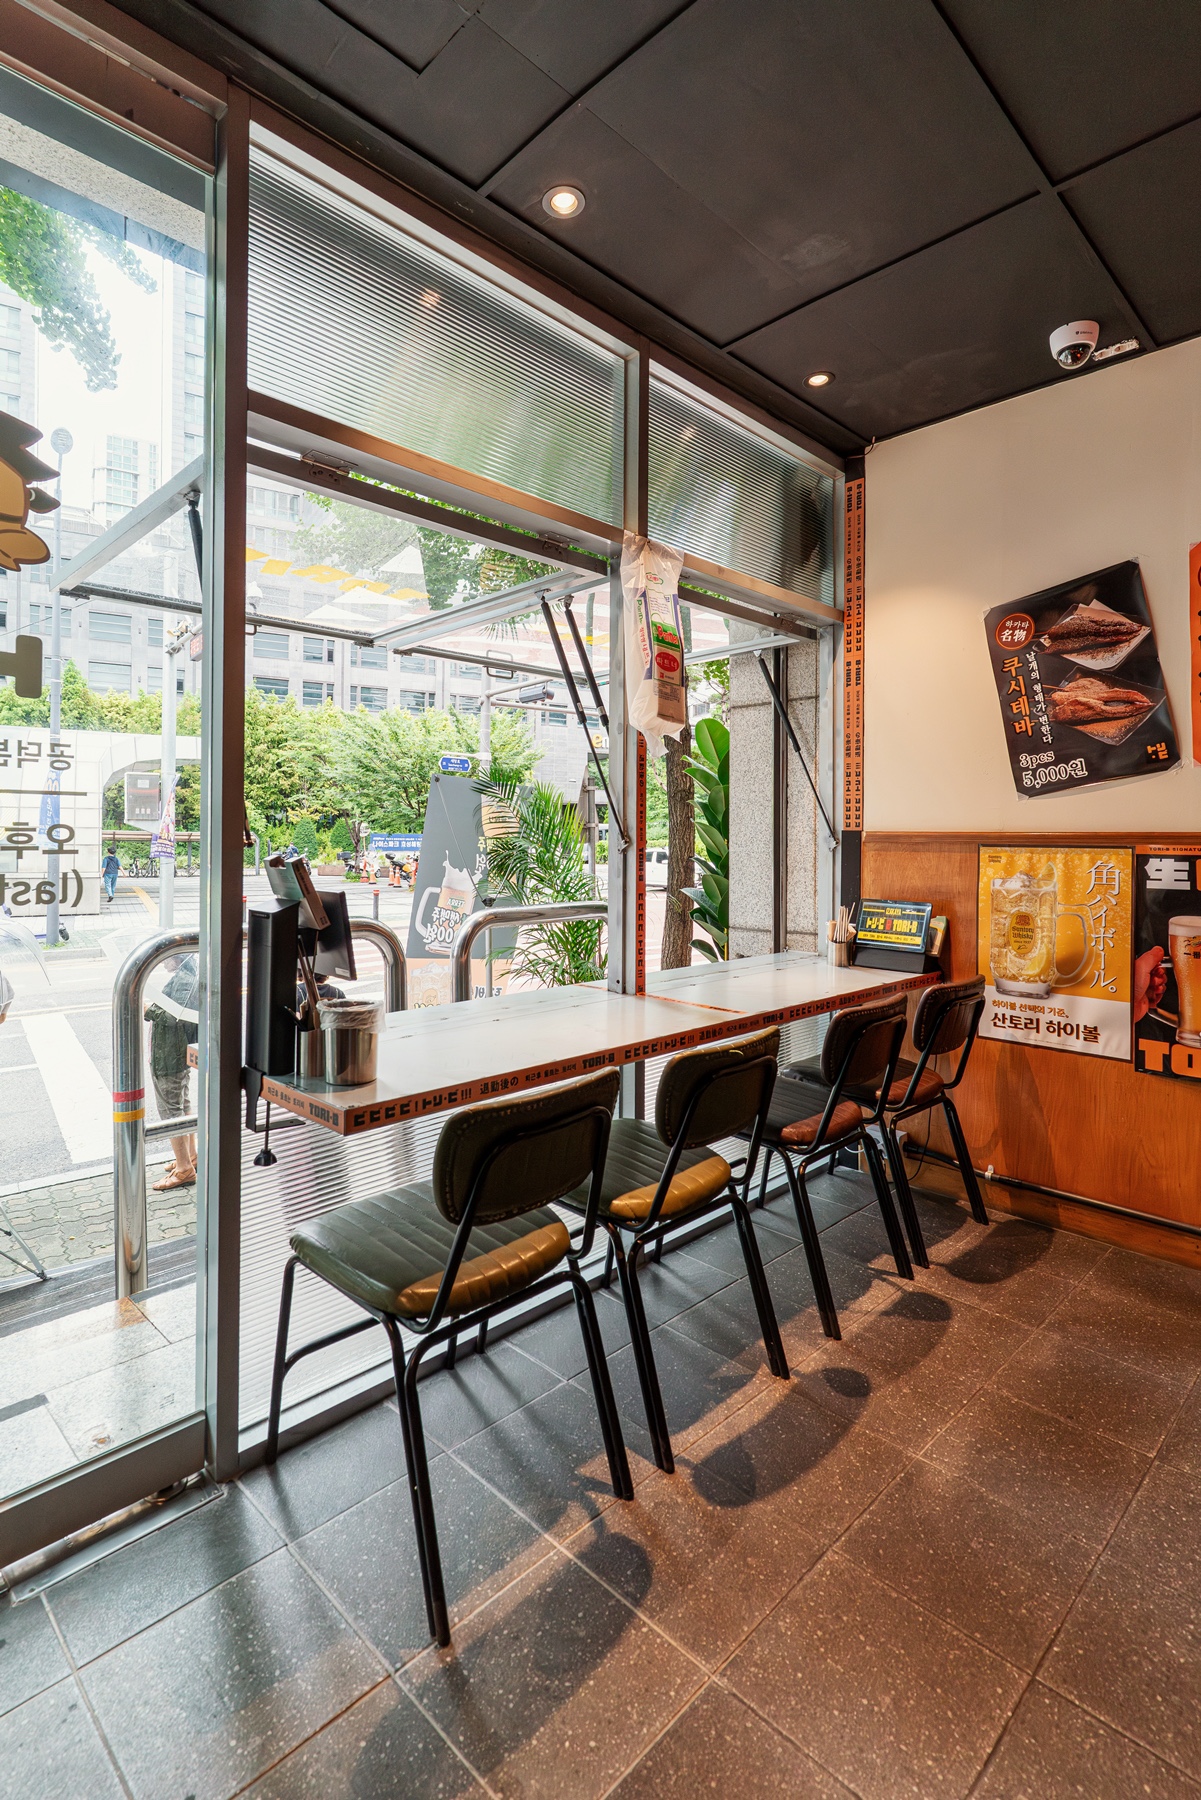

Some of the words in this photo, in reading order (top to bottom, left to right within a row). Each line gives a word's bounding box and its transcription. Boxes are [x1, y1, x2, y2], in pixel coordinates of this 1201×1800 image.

[1005, 620, 1030, 630] 하카타
[1000, 629, 1027, 642] 名物
[656, 657, 677, 671] 파트너
[1026, 651, 1041, 680] 날개의
[1001, 656, 1035, 737] 쿠시테바
[1032, 683, 1047, 712] 형태가
[1038, 714, 1054, 744] 변한다
[1019, 751, 1055, 769] 3pcs
[1022, 758, 1088, 788] 5,000원
[892, 919, 918, 933] TORI-B
[1012, 926, 1034, 934] Suntory
[992, 999, 1017, 1011] 하이볼
[991, 1012, 1040, 1034] 산토리
[1045, 1020, 1101, 1043] 하이볼
[582, 1052, 615, 1070] TORI-B
[480, 1076, 518, 1095] 退勤後の
[309, 1102, 339, 1127] TORI-B
